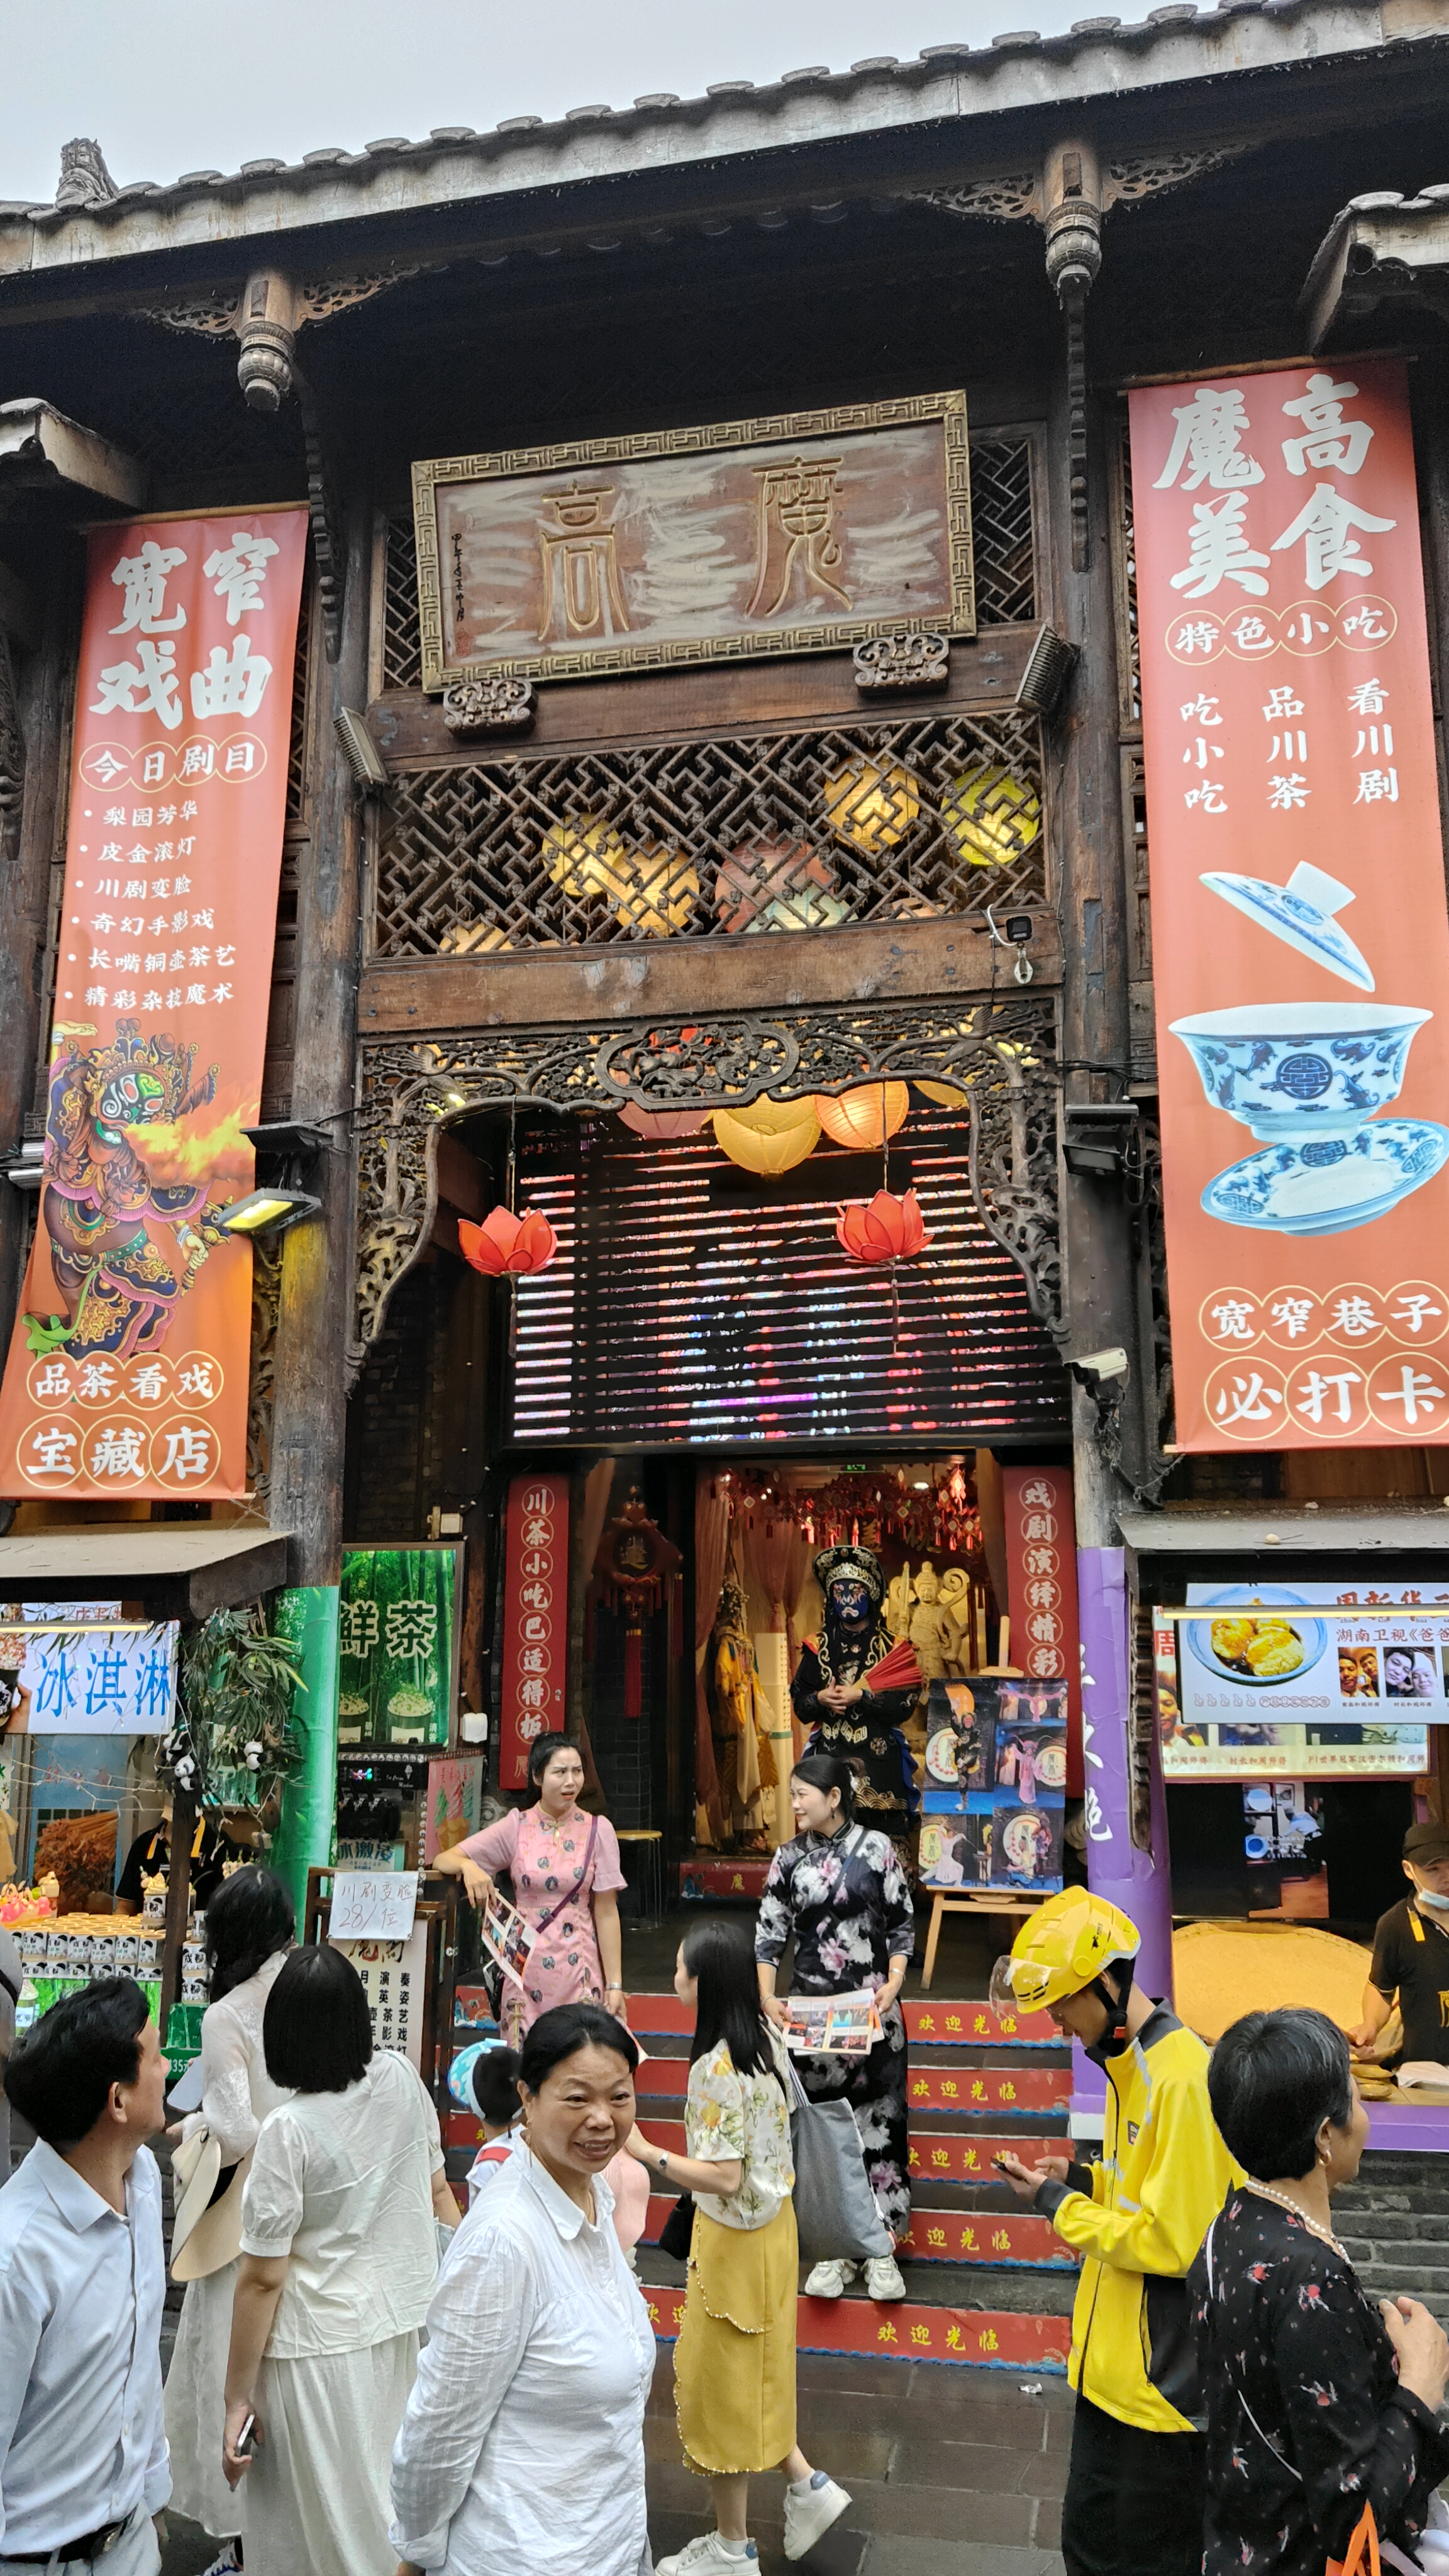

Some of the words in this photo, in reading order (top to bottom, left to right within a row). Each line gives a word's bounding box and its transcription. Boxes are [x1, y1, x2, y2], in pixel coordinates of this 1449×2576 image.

[1170, 482, 1398, 599] 美食
[109, 532, 280, 635] 宽窄
[1175, 606, 1389, 654] 特色小吃
[89, 633, 273, 730] 戏曲
[86, 743, 255, 782] 今日剧目
[1179, 692, 1228, 814] 吃小吃
[1262, 684, 1312, 811] 品川茶
[1348, 677, 1399, 804] 看川剧
[103, 799, 199, 828] 梨园芳华
[97, 835, 197, 865] 皮金滚灯
[94, 876, 192, 899] 川剧变脸
[90, 908, 215, 938] 奇幻手影戏
[87, 944, 236, 974] 长嘴铜壶茶艺
[84, 982, 234, 1011] 精彩杂技魔术
[1211, 1294, 1443, 1340] 宽窄巷子
[35, 1362, 214, 1401] 品茶看戏
[1216, 1365, 1446, 1426] 必打卡
[26, 1426, 211, 1480] 宝藏店
[1024, 1481, 1060, 1677] 戏剧演绎精彩
[520, 1488, 550, 1740] 川茶小吃巴适得板
[36, 1648, 170, 1718] 冰淇淋
[341, 1881, 414, 1902] 川剧变脸
[918, 2014, 1018, 2035] 欢迎光临
[913, 2079, 1017, 2101] 欢迎光临
[877, 2323, 1001, 2352] 欢迎光临
